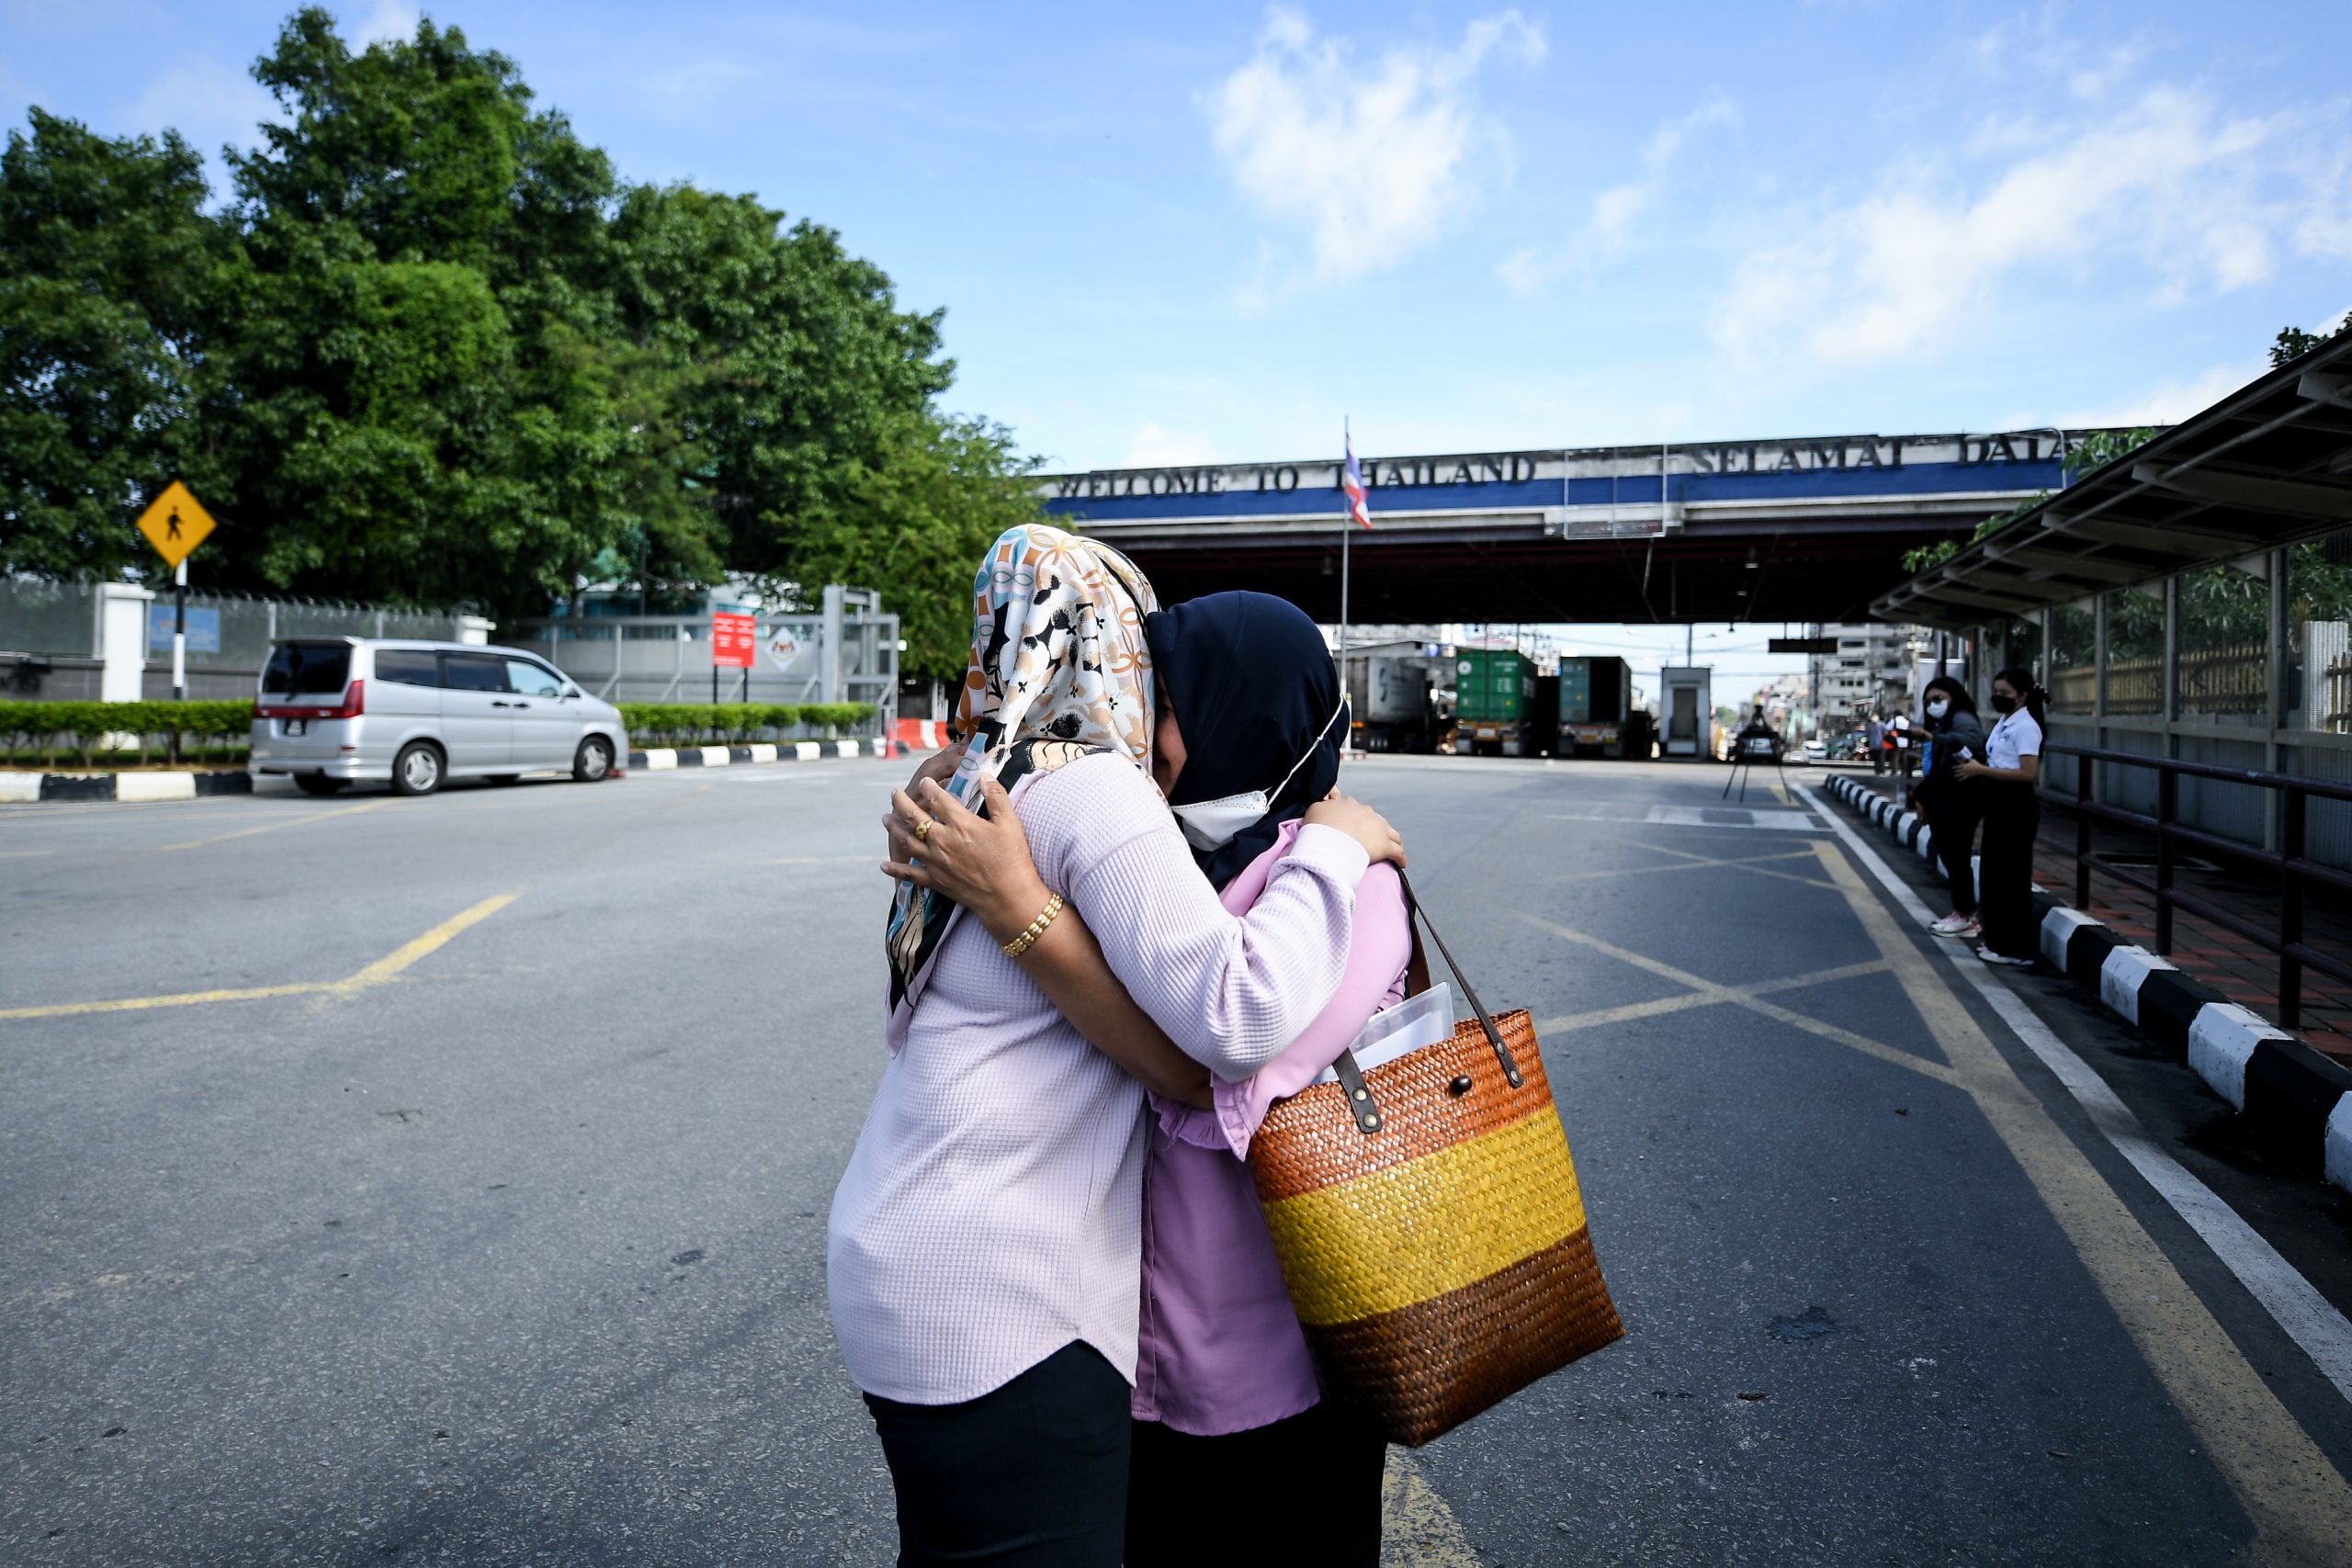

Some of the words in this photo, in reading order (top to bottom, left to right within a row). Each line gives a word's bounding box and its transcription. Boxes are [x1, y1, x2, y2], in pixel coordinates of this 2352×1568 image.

[1054, 467, 1227, 500] WELCOME
[1250, 465, 1299, 495] TO
[1325, 454, 1536, 493] THAILAND
[1691, 438, 1912, 478] SELAMAT
[1955, 434, 2084, 468] DATA
